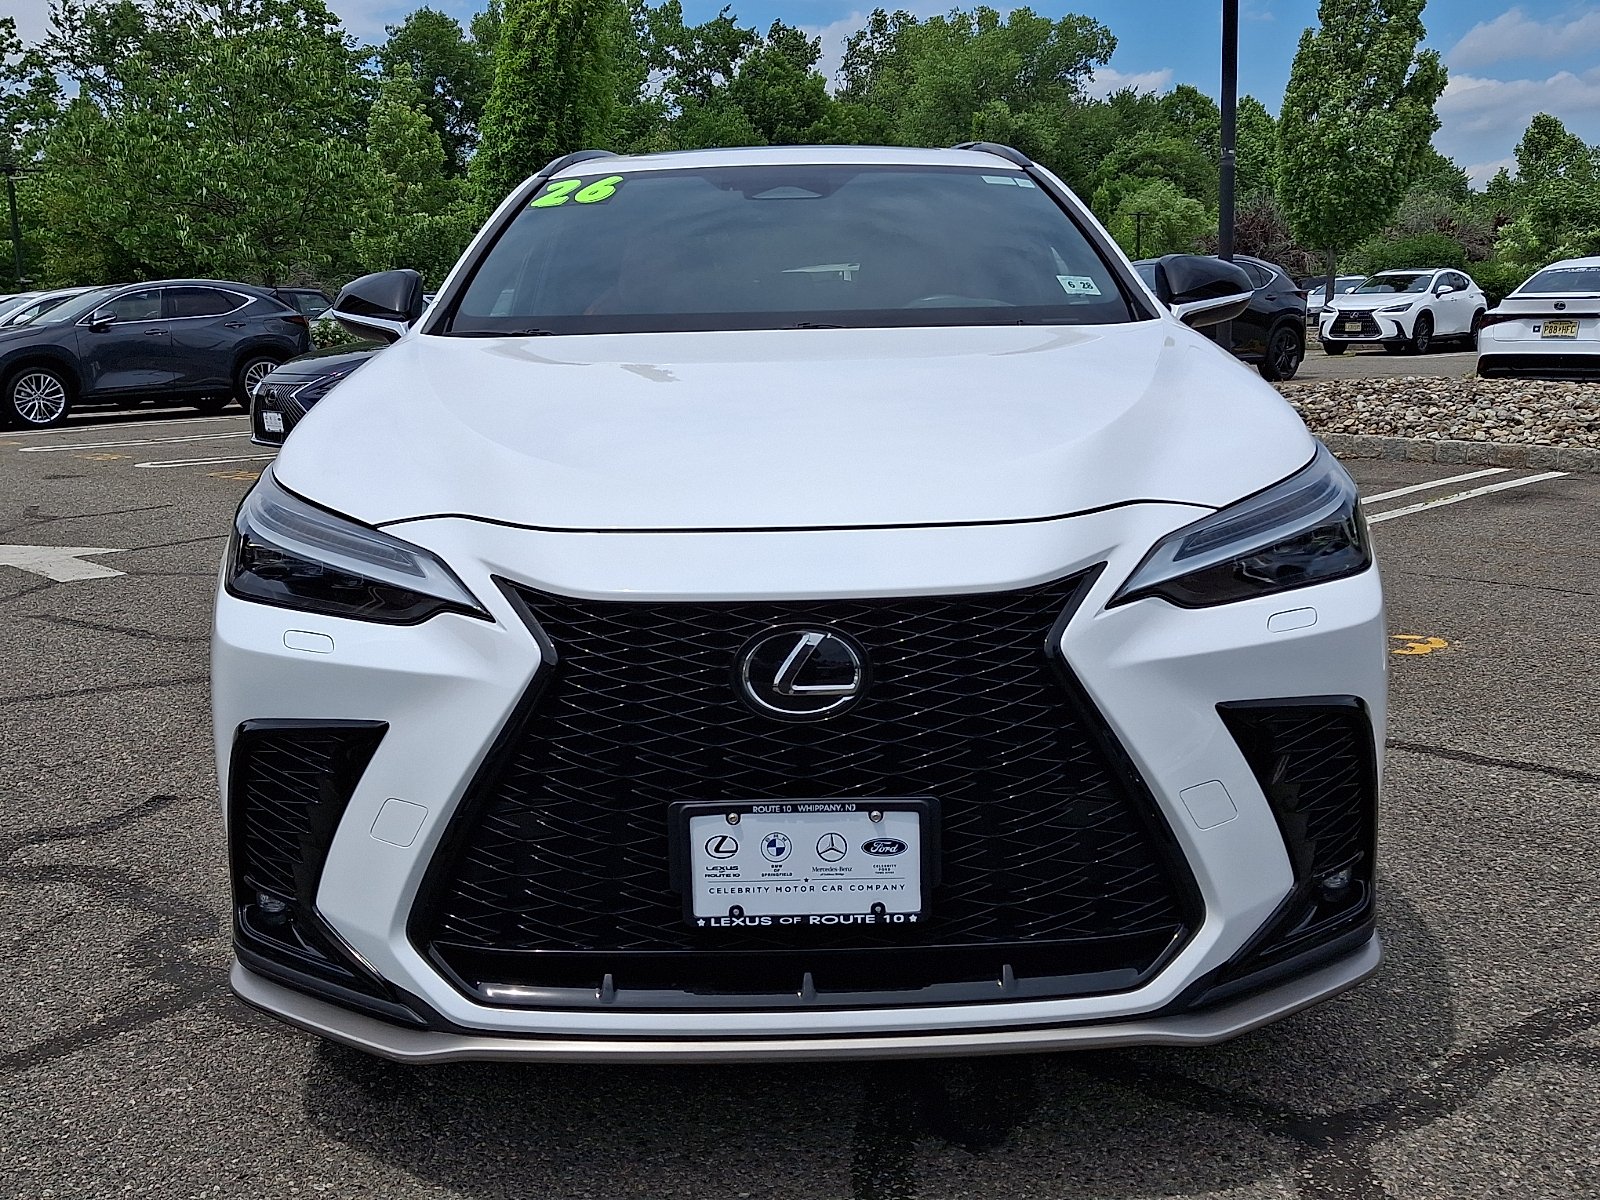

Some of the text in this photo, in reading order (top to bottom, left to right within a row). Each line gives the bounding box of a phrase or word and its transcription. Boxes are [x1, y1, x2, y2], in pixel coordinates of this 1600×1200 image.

[530, 175, 625, 208] 26
[1067, 280, 1094, 290] 6 28
[752, 803, 857, 813] ROUTE 10 WHIPPANY, NJ
[870, 841, 899, 853] Ford
[708, 886, 770, 894] CELEBRITY
[775, 885, 815, 893] MOTOR
[710, 914, 905, 927] LEXUS OF ROUTE 10
